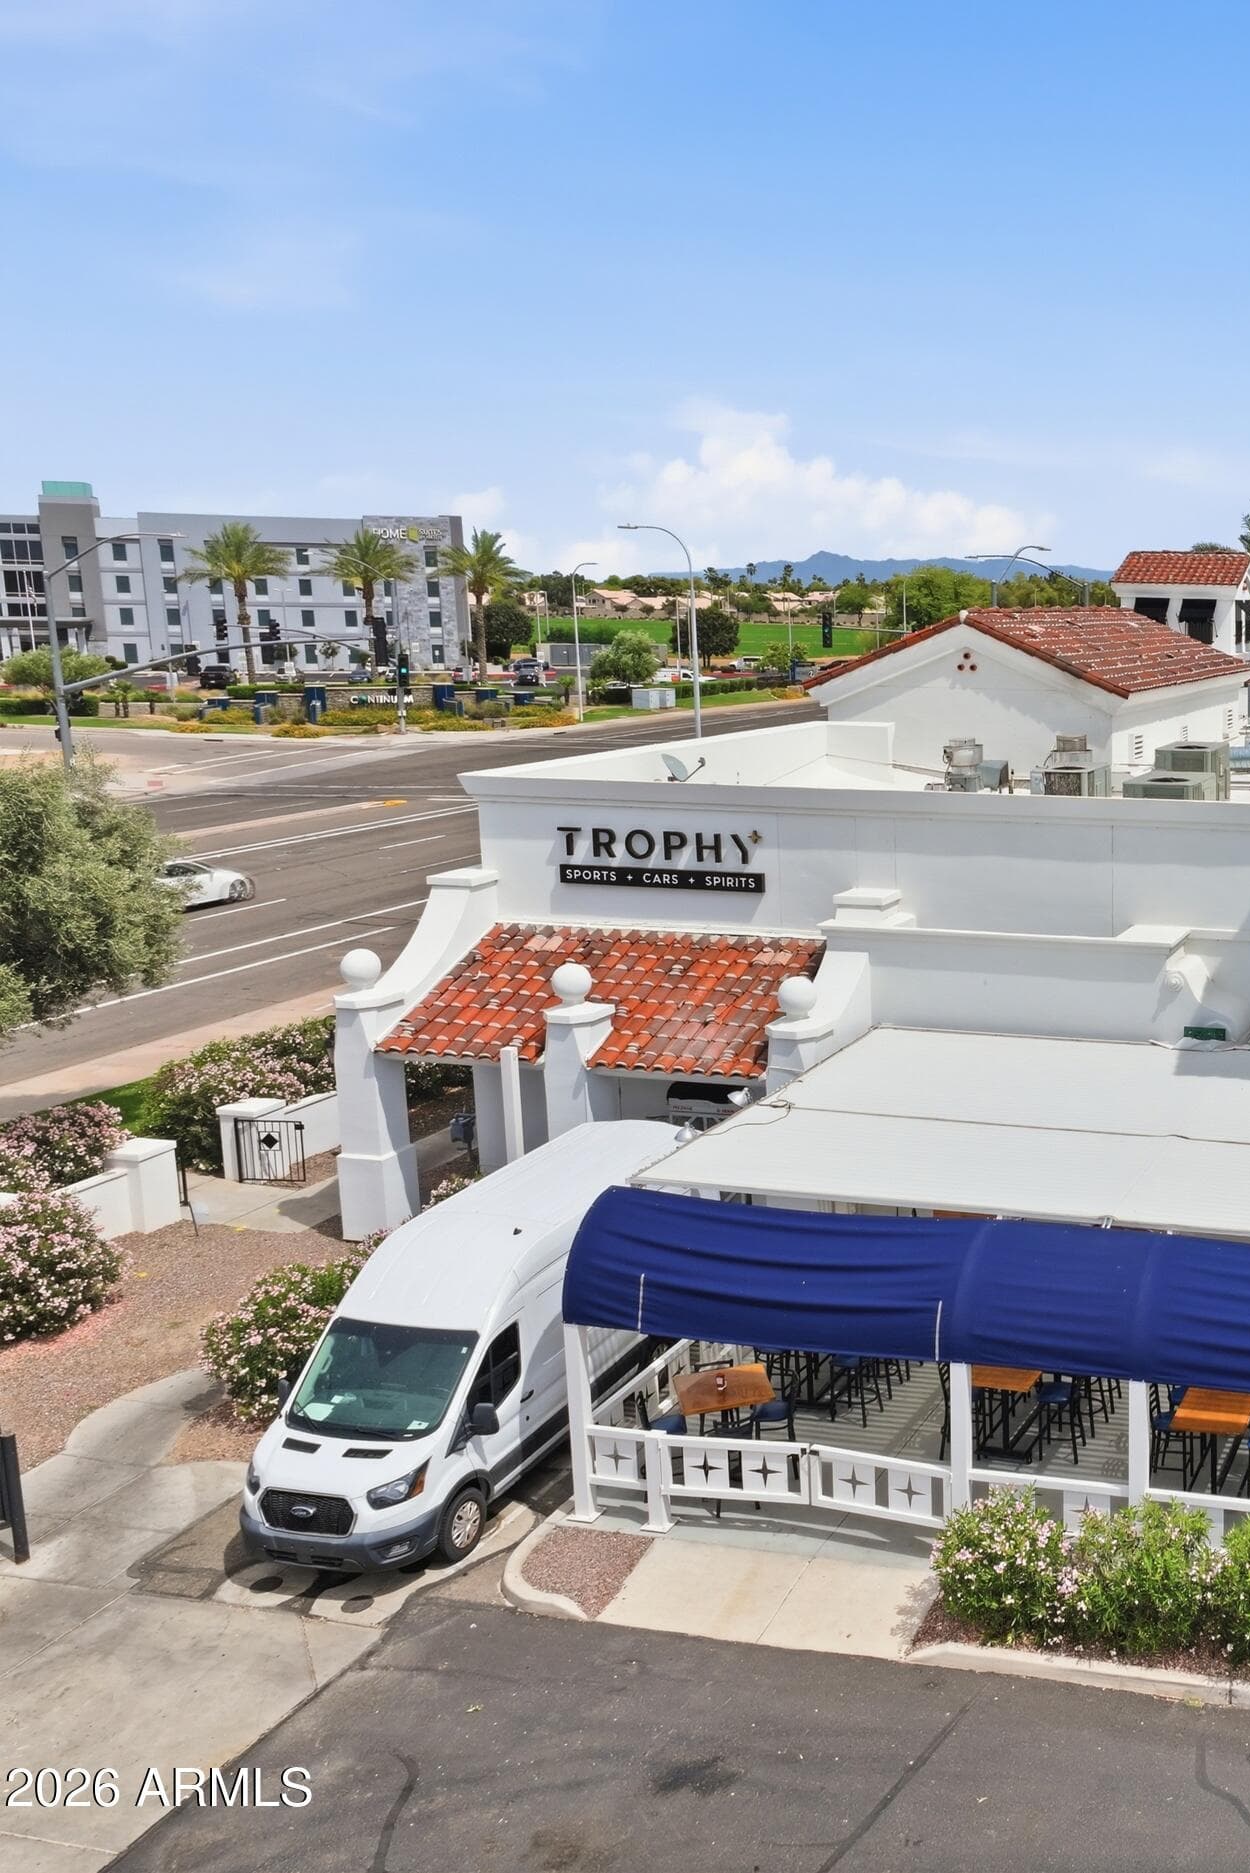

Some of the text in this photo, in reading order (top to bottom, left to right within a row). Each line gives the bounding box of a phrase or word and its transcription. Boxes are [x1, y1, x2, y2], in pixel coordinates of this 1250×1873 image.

[350, 694, 414, 704] CONTINUM
[556, 826, 760, 865] TROPHY
[566, 869, 617, 882] SPORTS
[642, 873, 678, 885] CARS
[705, 876, 756, 889] SPIRITS
